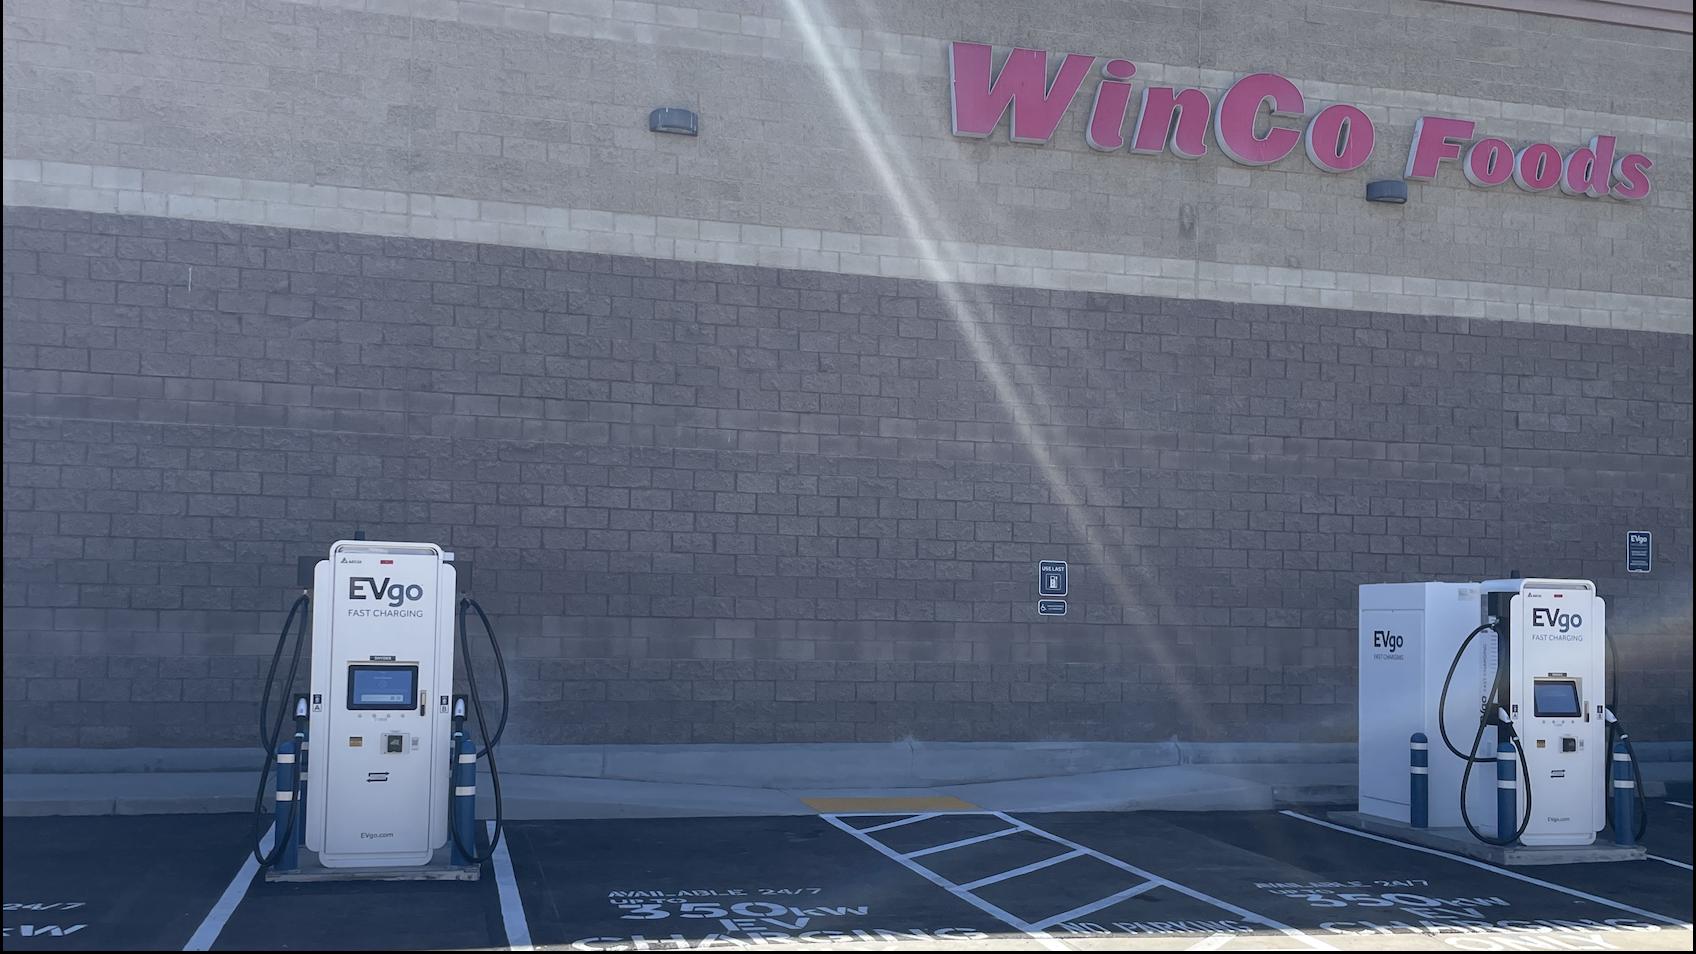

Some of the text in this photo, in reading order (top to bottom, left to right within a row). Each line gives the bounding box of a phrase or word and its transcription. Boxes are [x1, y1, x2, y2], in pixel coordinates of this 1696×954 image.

[949, 41, 1653, 201] WinCo Foods
[1631, 535, 1647, 544] EVgo
[349, 577, 423, 607] EVgo
[348, 609, 424, 618] FAST CHARGING
[1533, 608, 1582, 633] EVgo
[1374, 630, 1403, 652] EVgo
[1549, 634, 1583, 642] CHARGING
[360, 832, 394, 840] EVgo.com
[608, 888, 822, 898] AVAILABLE 24/7
[1400, 907, 1486, 919] EV
[719, 917, 810, 933] EV
[1058, 920, 1254, 935] NO PARKING
[1320, 919, 1661, 934] CHARGING
[571, 926, 989, 952] CHARGING
